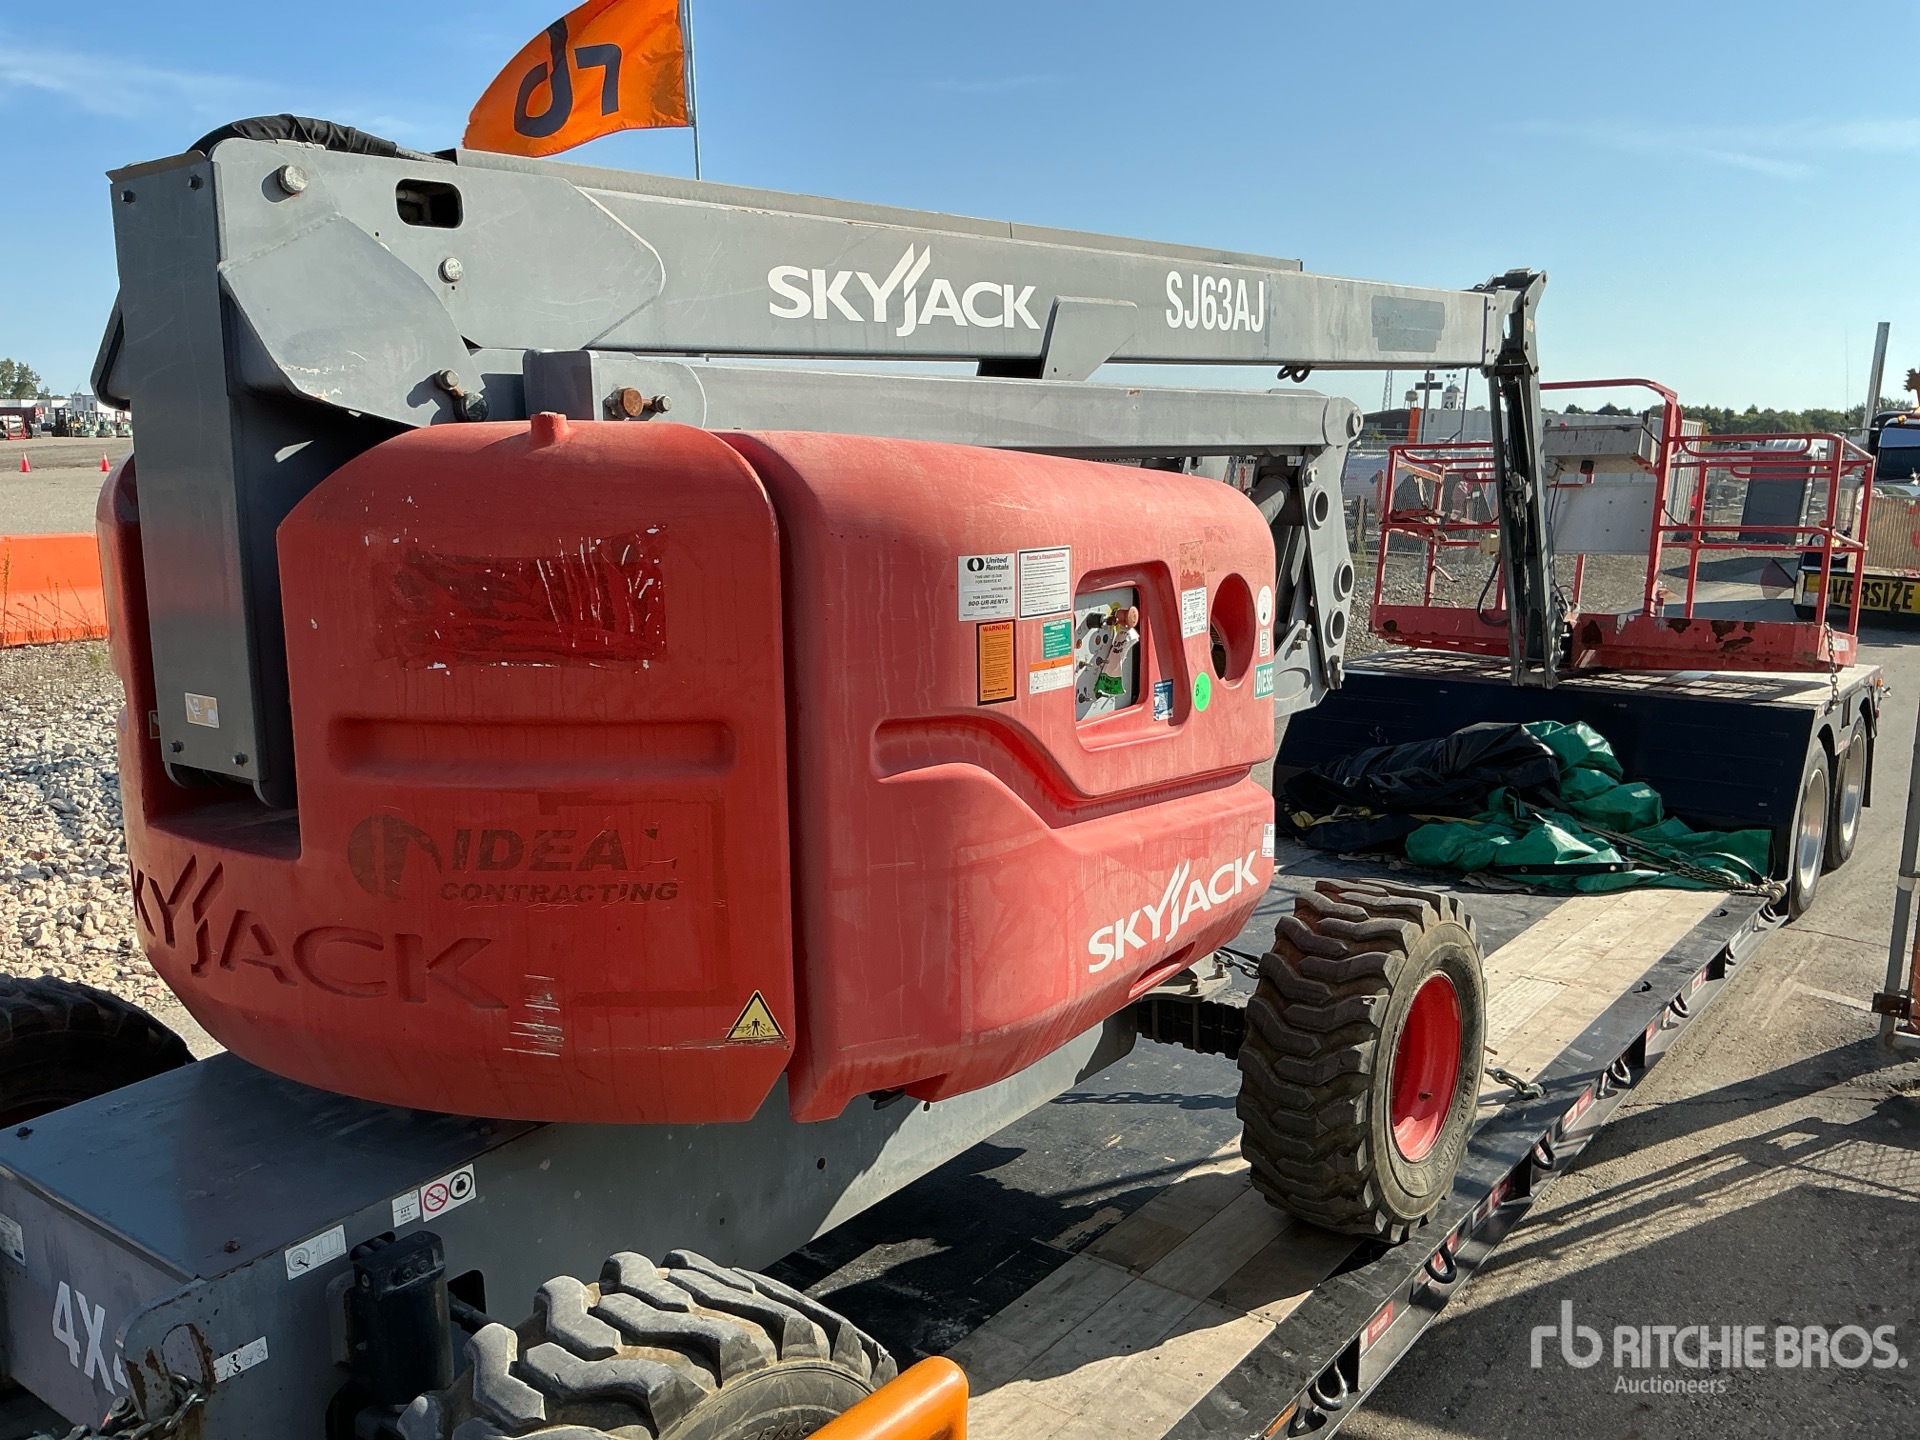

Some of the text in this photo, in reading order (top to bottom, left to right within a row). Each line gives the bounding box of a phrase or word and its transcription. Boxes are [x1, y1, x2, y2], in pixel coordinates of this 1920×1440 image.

[767, 242, 1040, 337] SKYJACK
[1166, 271, 1265, 332] SJ63AJ
[986, 556, 1008, 564] United
[1828, 578, 1915, 611] VERSIZE
[983, 624, 1010, 632] WARNING
[1256, 667, 1274, 695] DIESE
[440, 881, 679, 902] CONTRACTING
[1088, 849, 1259, 975] SKYJACK
